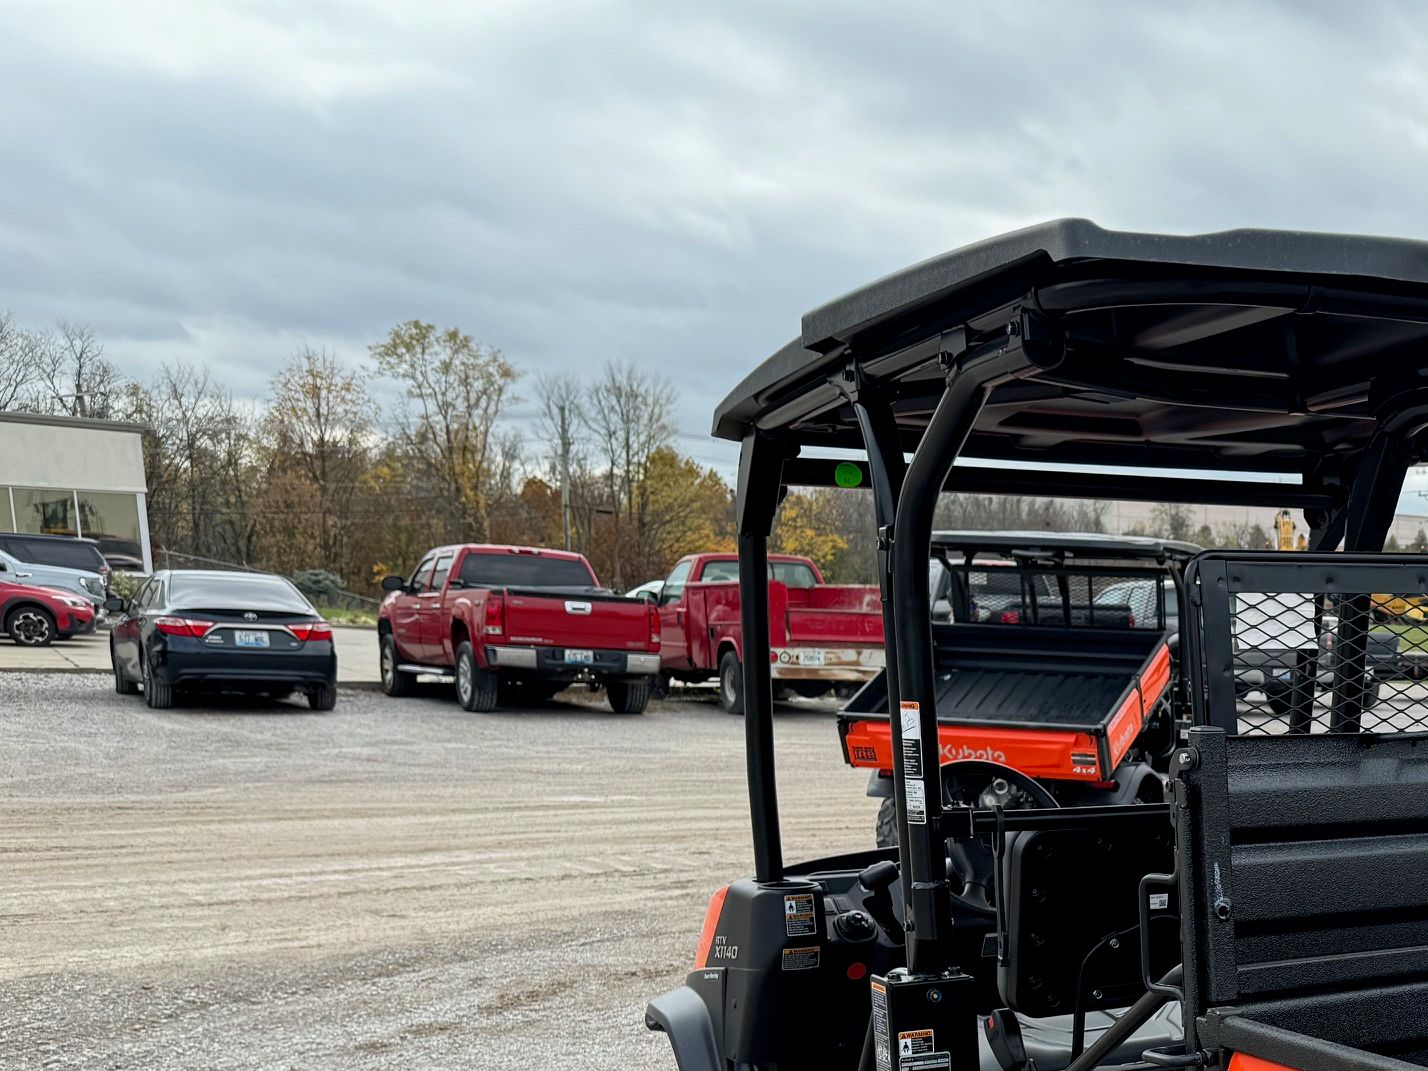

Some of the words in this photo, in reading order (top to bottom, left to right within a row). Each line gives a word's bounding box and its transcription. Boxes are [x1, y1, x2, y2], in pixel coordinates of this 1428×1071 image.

[1072, 766, 1097, 775] 4x4
[715, 935, 728, 945] RTV
[714, 945, 739, 959] X1140
